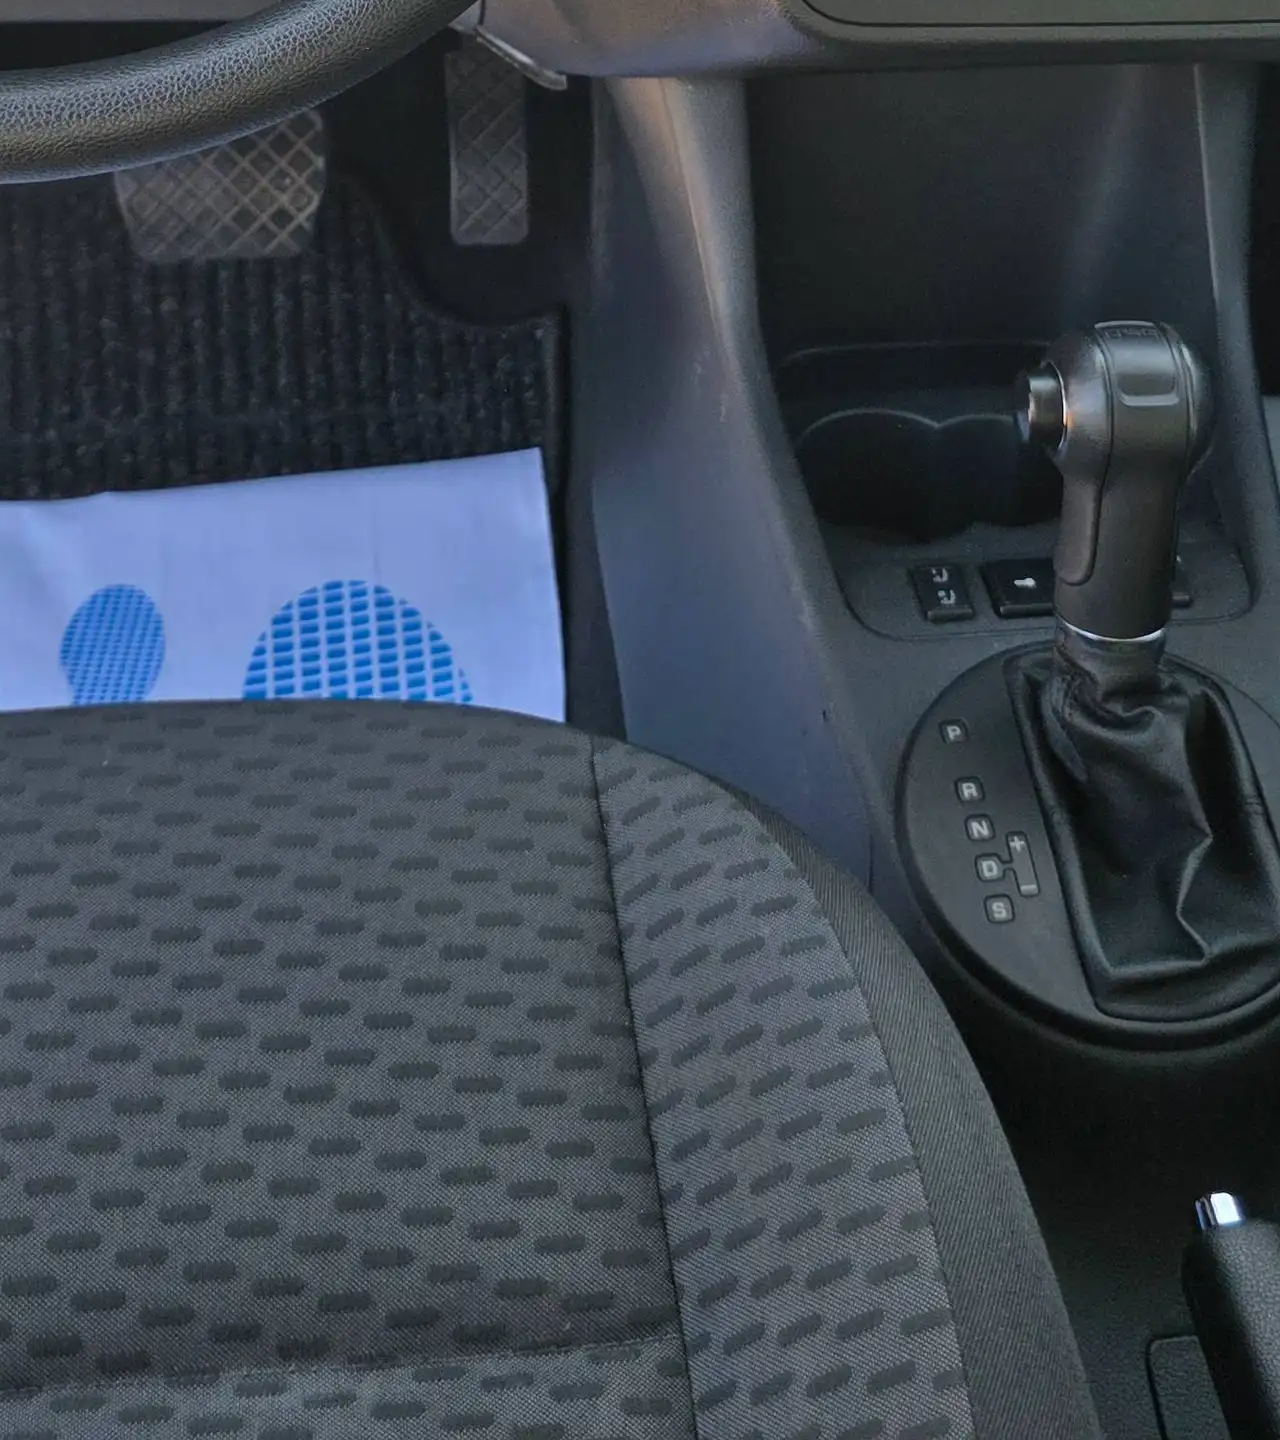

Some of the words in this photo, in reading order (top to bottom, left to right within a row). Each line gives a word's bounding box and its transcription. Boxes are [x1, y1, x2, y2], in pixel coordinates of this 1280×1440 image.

[947, 725, 962, 741] P
[961, 782, 979, 799] R
[971, 820, 990, 838] N
[981, 860, 998, 877] D
[991, 902, 1008, 919] S
